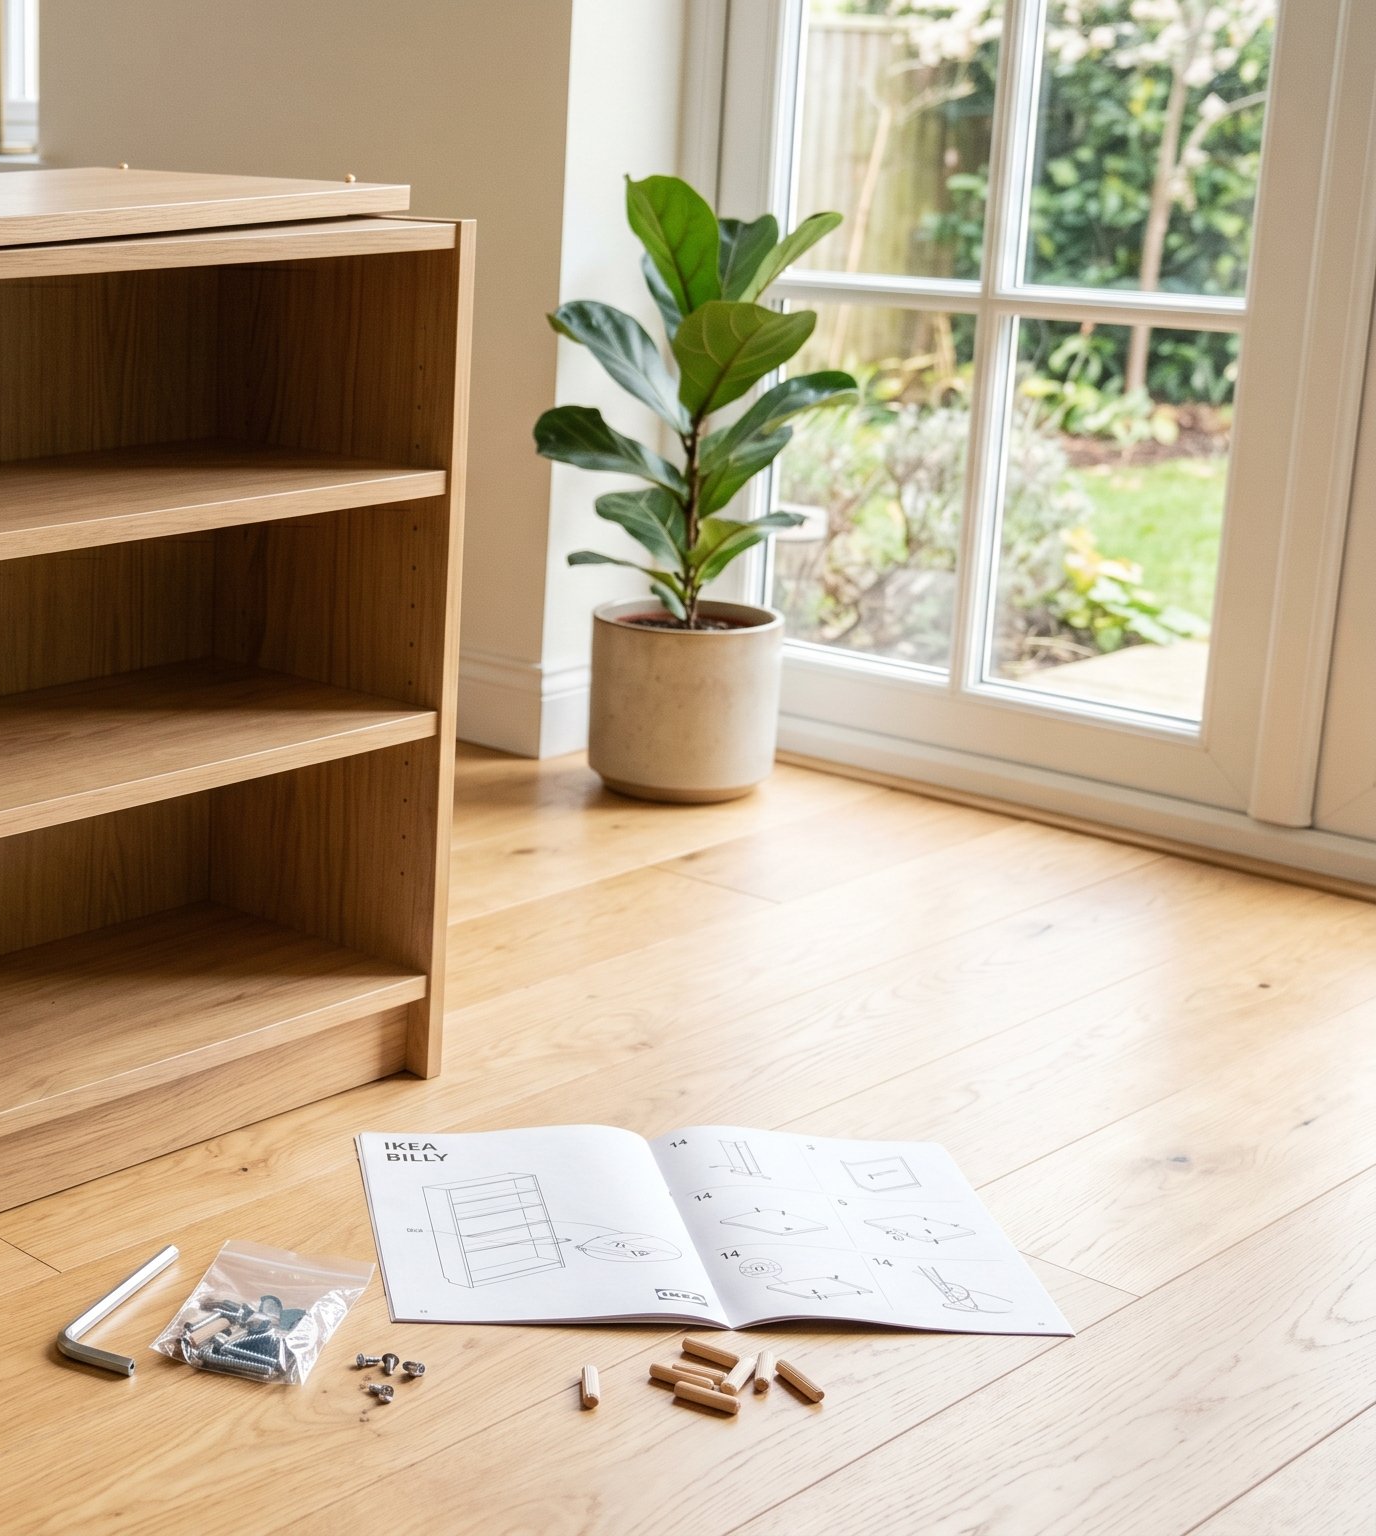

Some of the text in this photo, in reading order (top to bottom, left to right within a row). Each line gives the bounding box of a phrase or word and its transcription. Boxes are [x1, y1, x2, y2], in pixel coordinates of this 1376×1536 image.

[385, 1142, 437, 1151] IKEA
[387, 1153, 448, 1162] BILLY
[694, 1192, 712, 1201] 14
[721, 1250, 740, 1260] 14
[872, 1258, 893, 1267] 14
